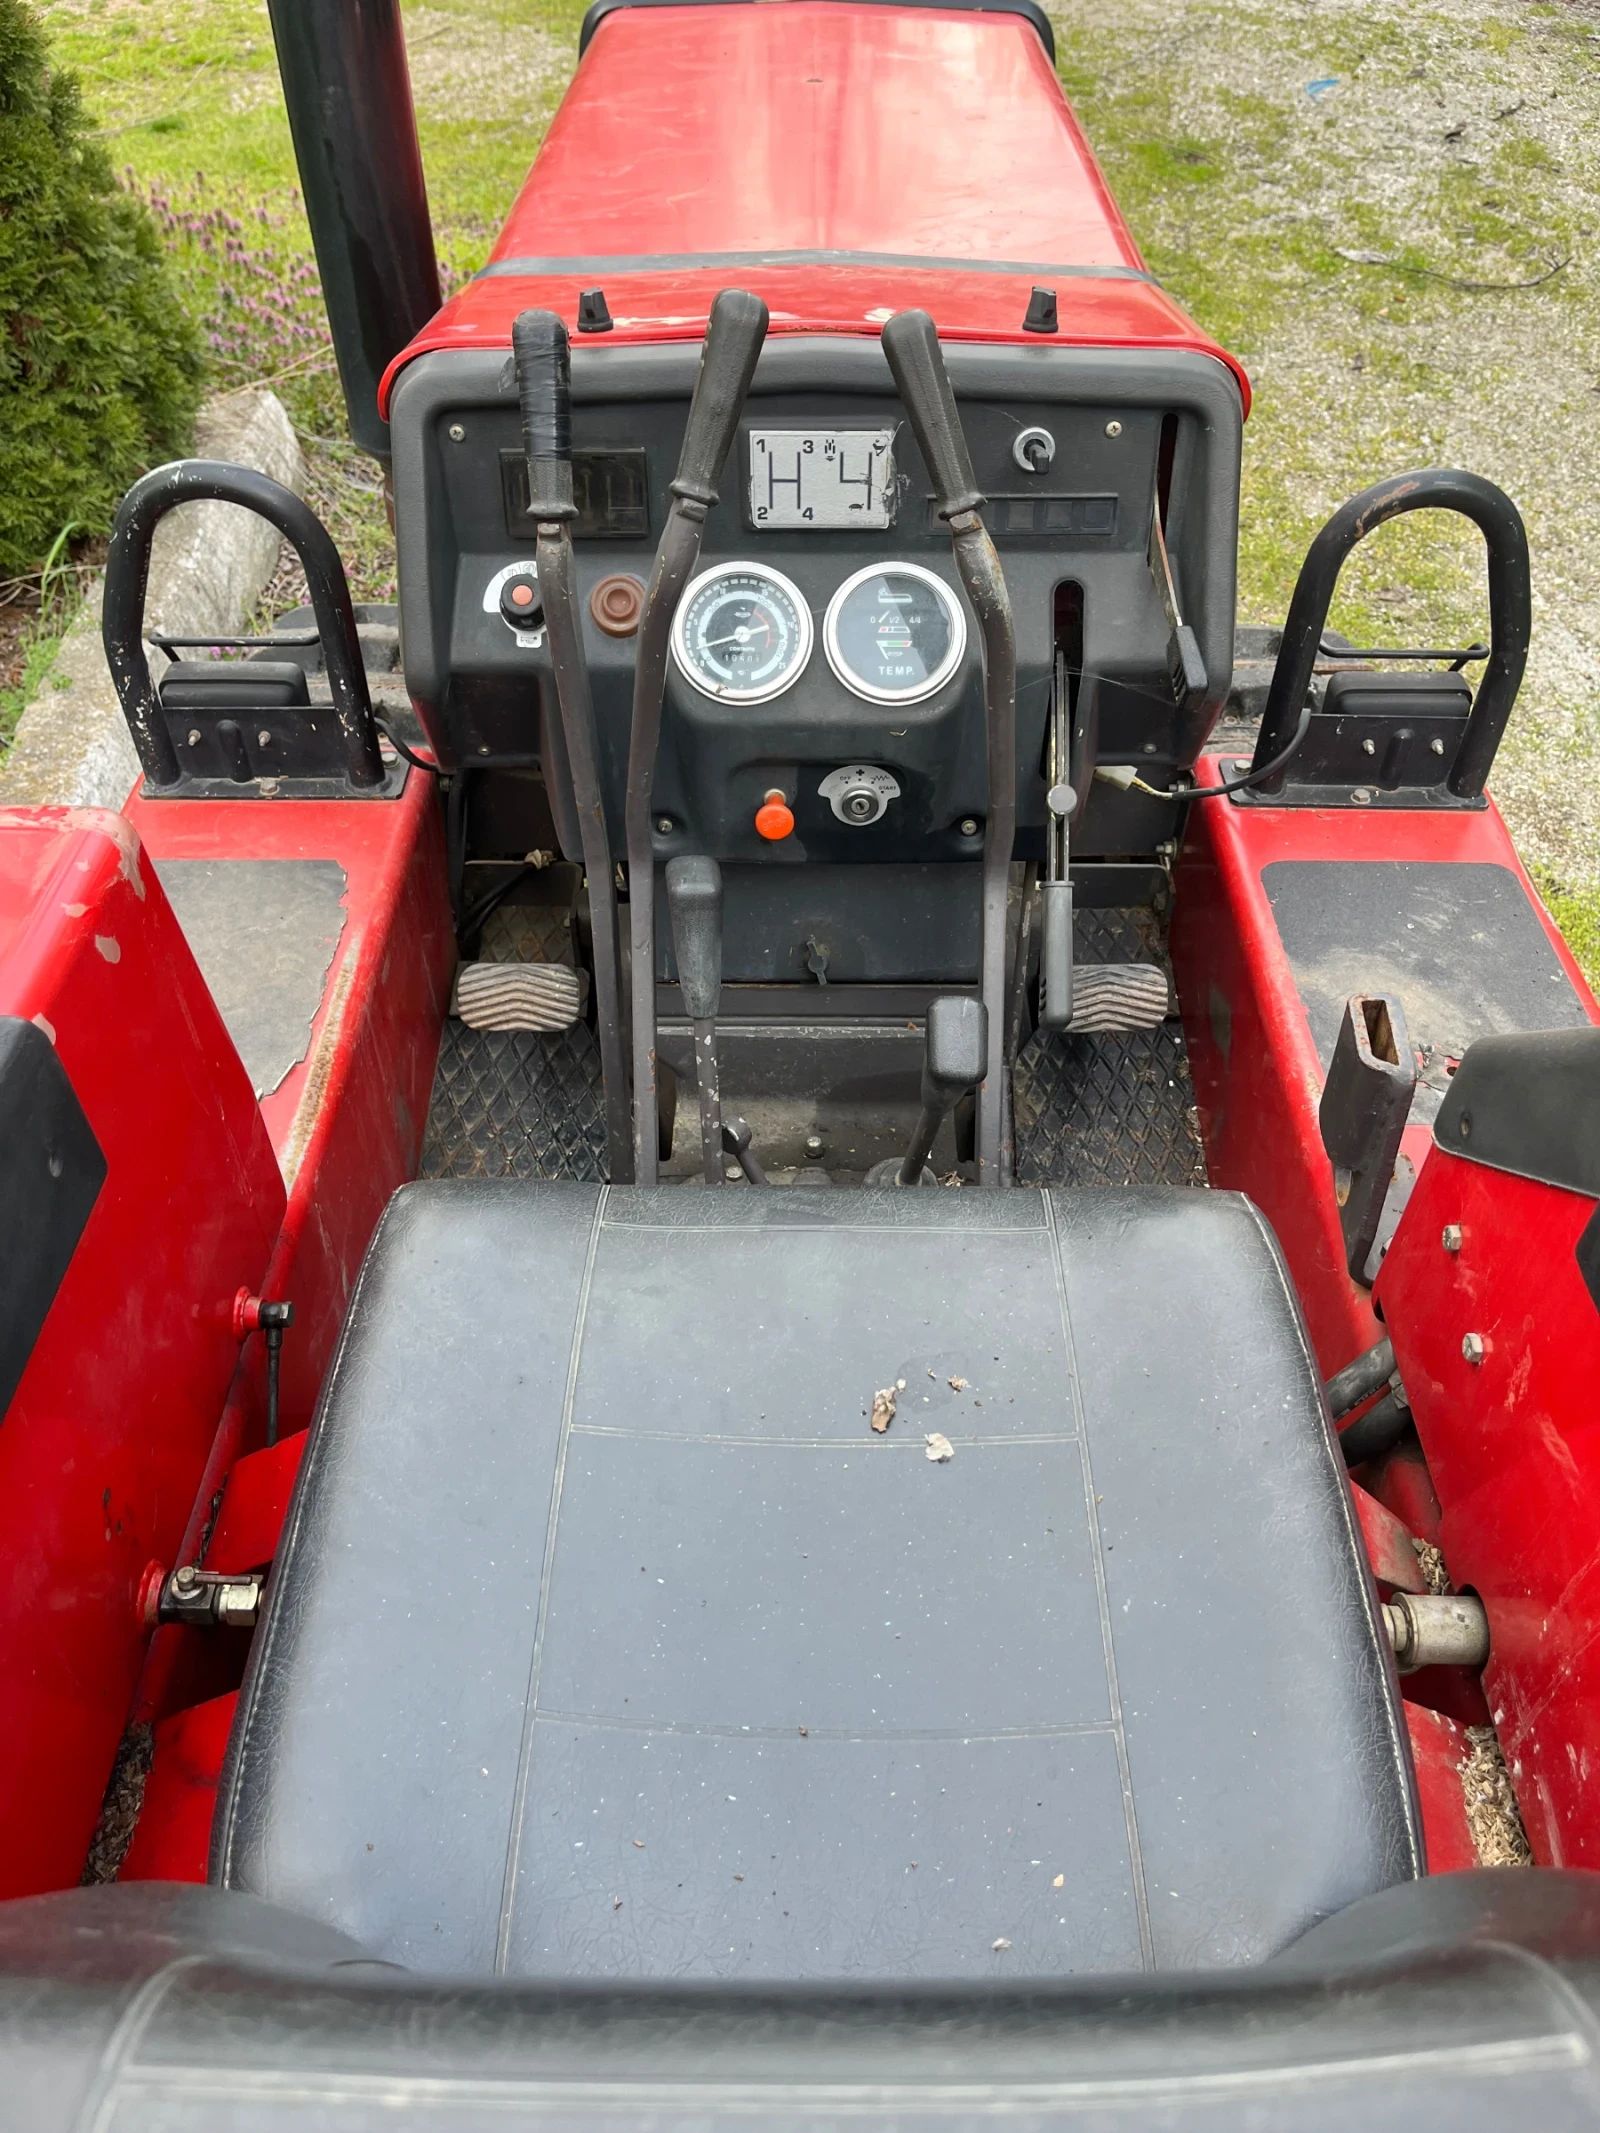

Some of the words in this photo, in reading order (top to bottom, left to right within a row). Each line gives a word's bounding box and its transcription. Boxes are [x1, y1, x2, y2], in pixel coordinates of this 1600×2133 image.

[756, 439, 765, 453] 1
[802, 440, 814, 454] 3
[757, 506, 768, 520] 2
[802, 507, 814, 521] 4
[870, 616, 876, 624] 0
